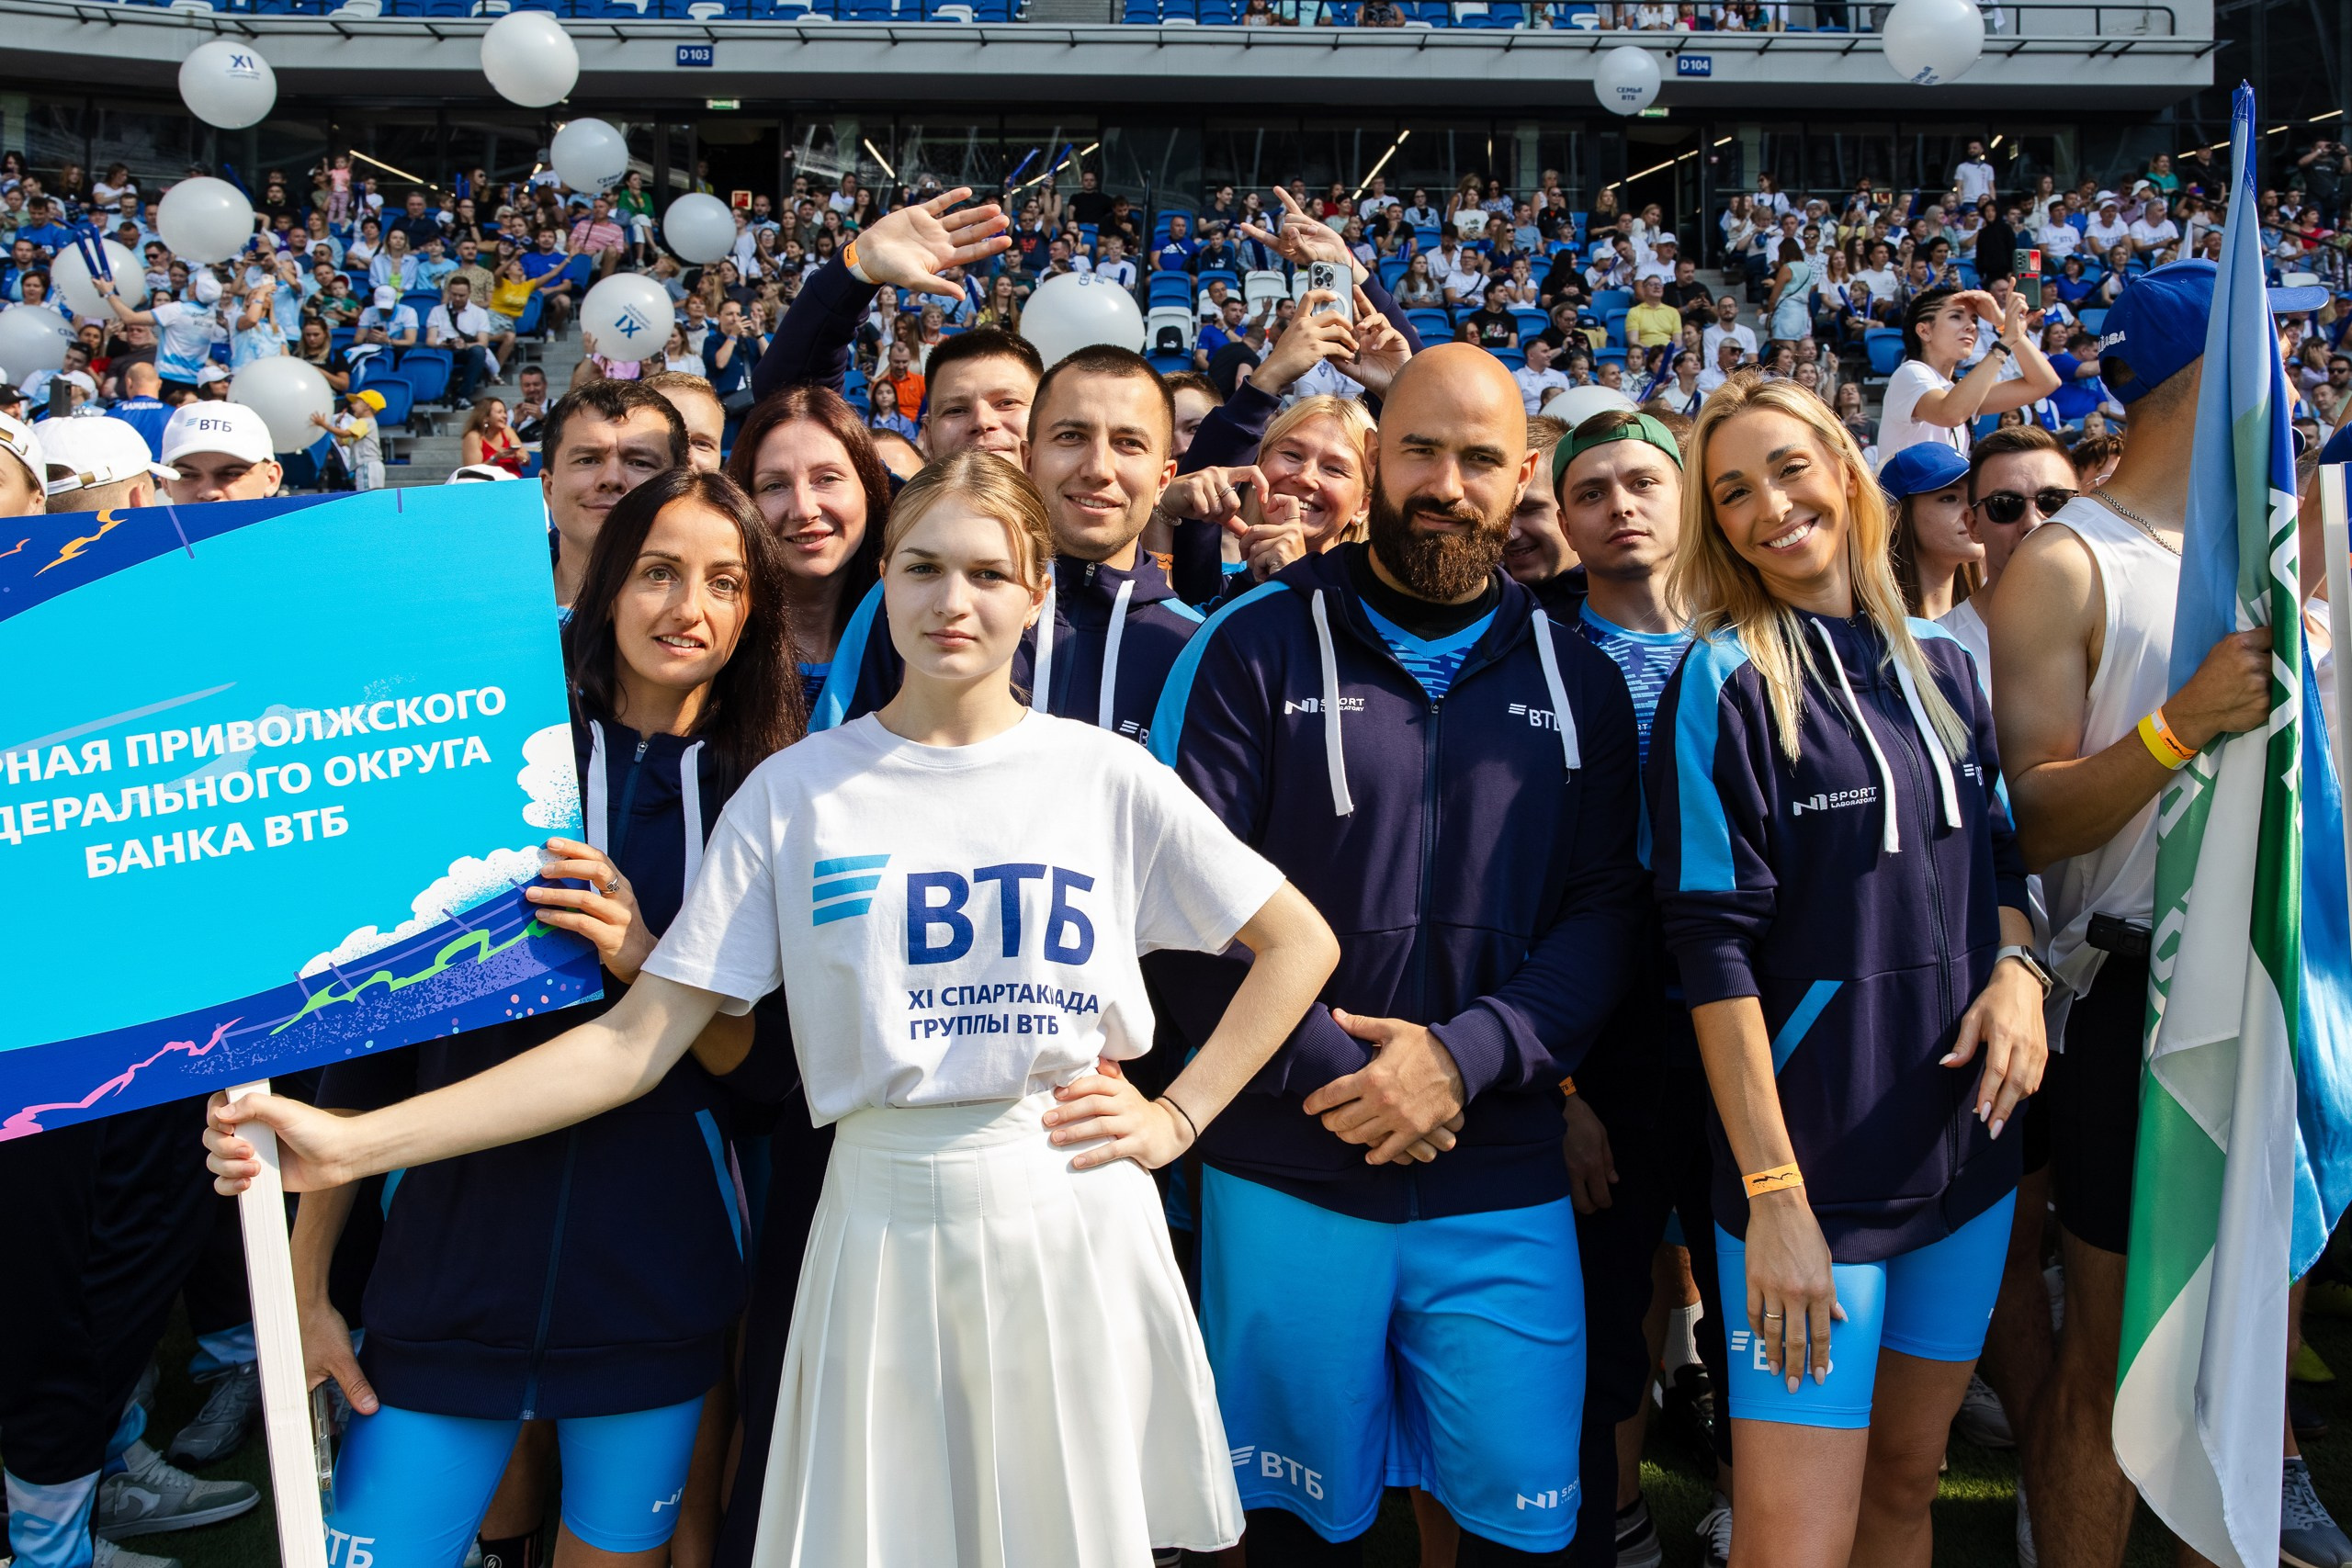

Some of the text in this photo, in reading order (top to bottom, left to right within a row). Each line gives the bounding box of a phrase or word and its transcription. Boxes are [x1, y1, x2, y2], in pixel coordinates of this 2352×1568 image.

[230, 55, 254, 69] XI
[679, 49, 710, 61] D 103
[1680, 59, 1709, 71] D 104
[615, 314, 641, 339] XI
[199, 419, 232, 433] ВТБ
[1320, 698, 1365, 706] SORT
[0, 686, 506, 785] НАЯ ПРИВОЛЖСКОГО
[323, 735, 492, 787] ОКРУГА
[1829, 786, 1877, 802] SPORT
[1830, 796, 1877, 809] LABORATORY
[85, 805, 349, 879] БАНКА ВТБ
[907, 863, 1096, 965] ВТБ
[910, 1013, 1059, 1040] ГРУППЫ ВТБ
[1261, 1450, 1323, 1501] ВТБ
